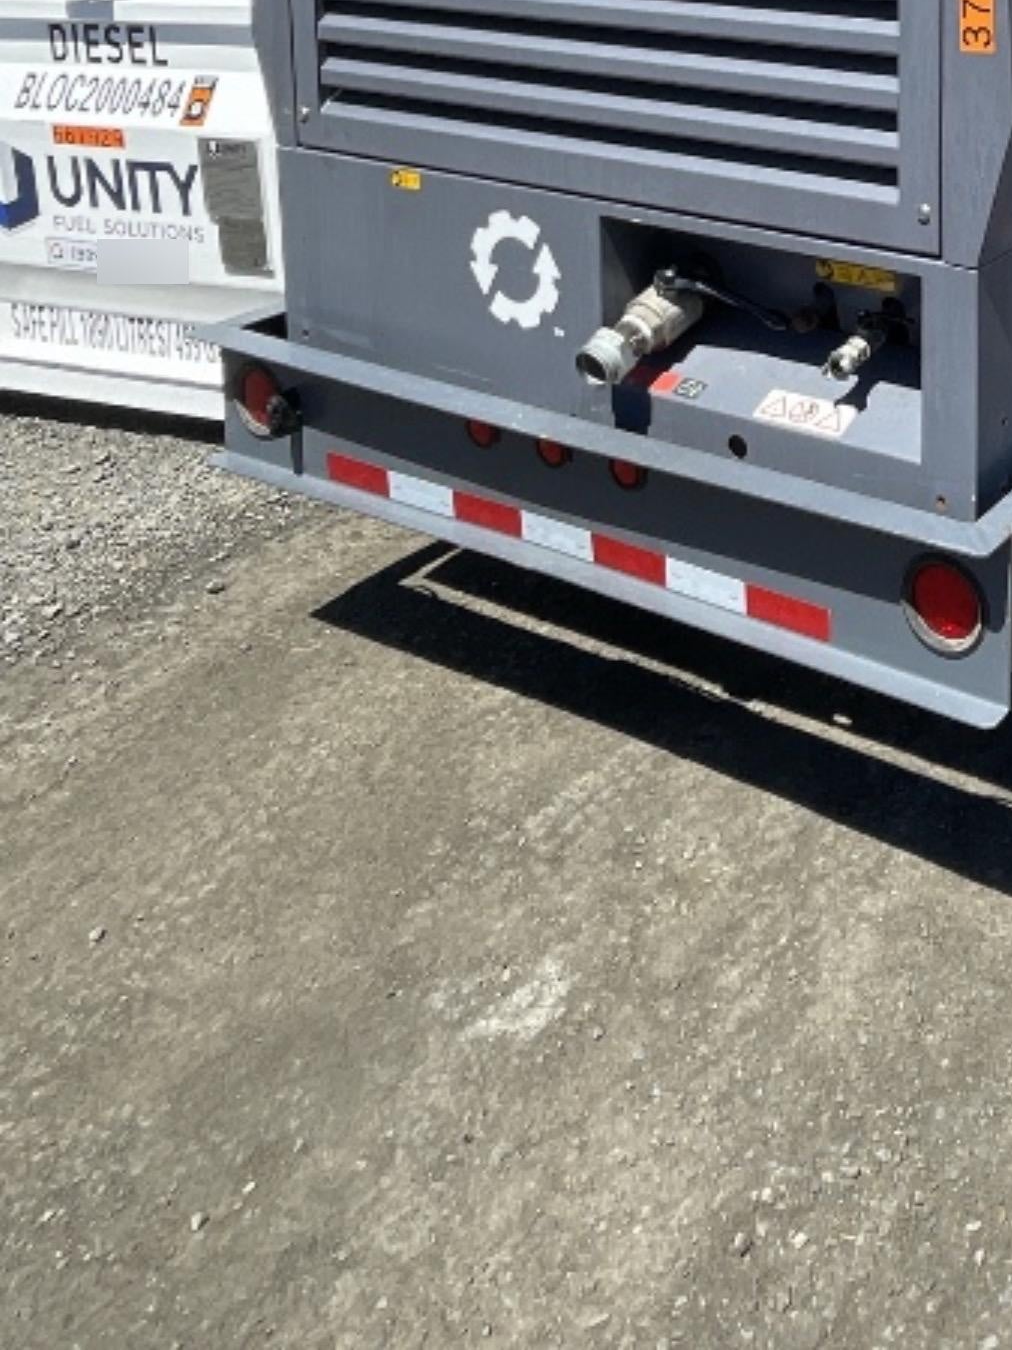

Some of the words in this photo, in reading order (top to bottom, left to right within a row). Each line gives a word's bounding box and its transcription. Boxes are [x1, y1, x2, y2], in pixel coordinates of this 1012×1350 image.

[49, 22, 169, 66] DIESEL
[47, 155, 199, 217] UNITY
[52, 215, 97, 235] FUEL
[103, 217, 206, 244] SOLUTIONS
